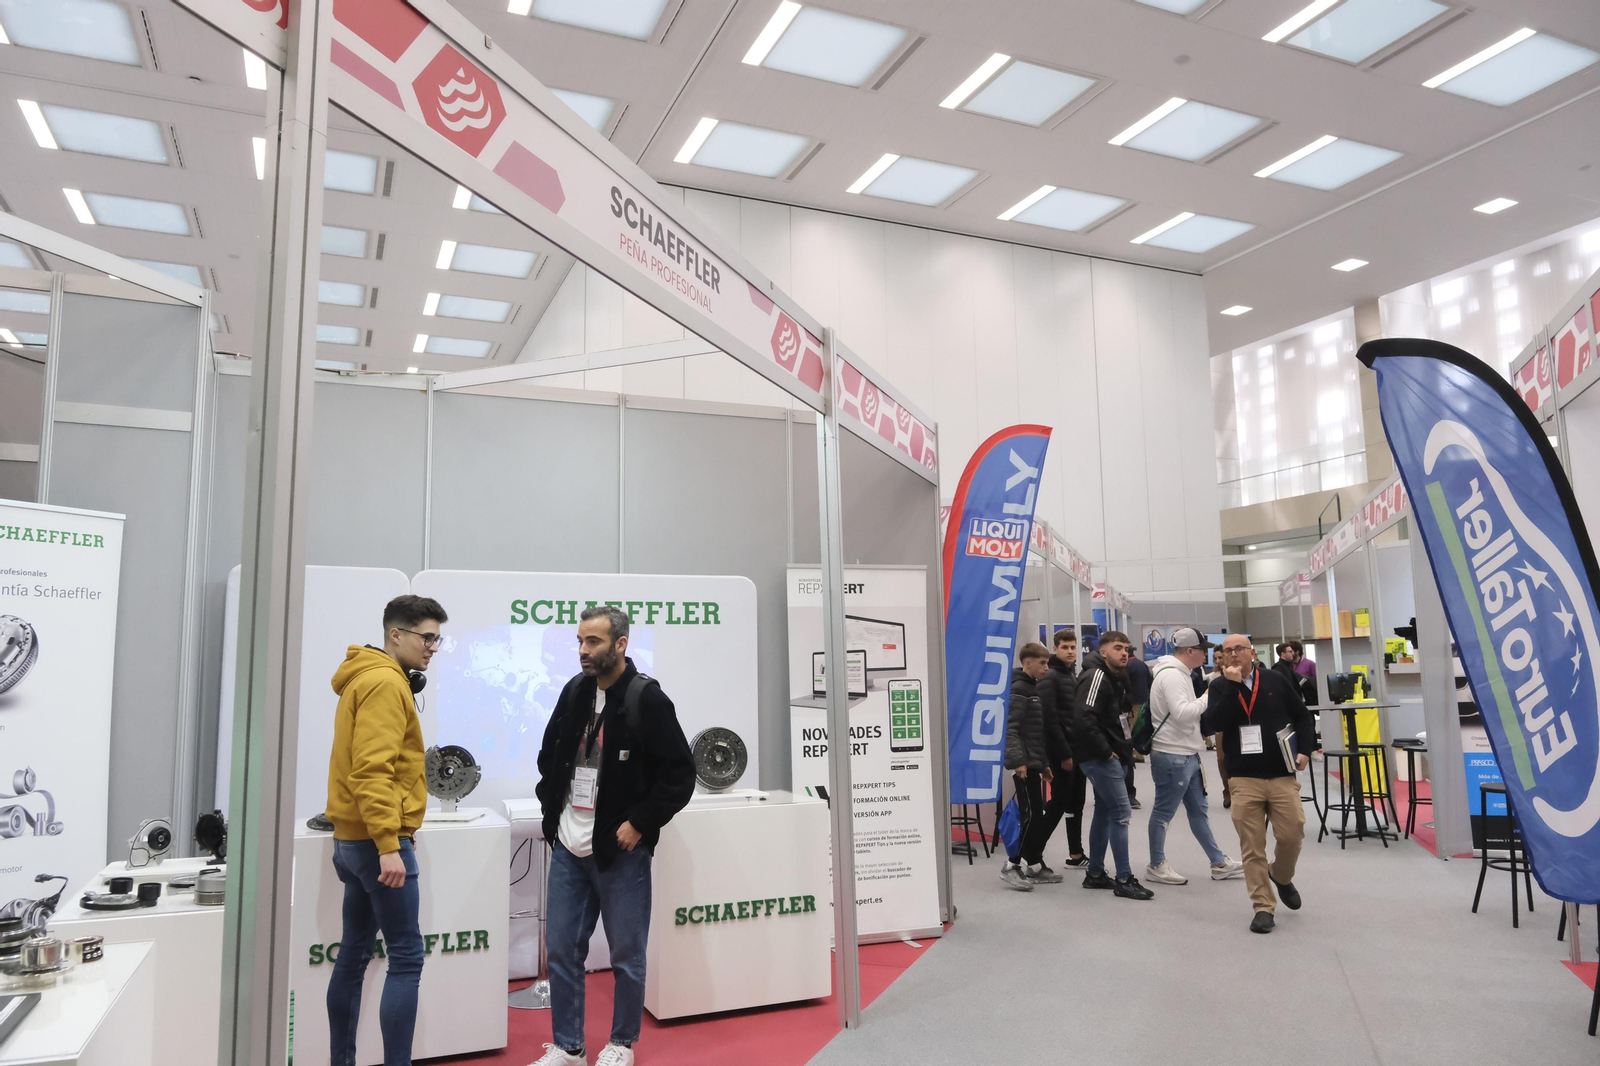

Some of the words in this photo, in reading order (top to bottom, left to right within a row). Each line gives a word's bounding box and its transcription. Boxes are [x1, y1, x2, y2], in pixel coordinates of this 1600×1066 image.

[611, 185, 720, 294] SCHAEFFLER
[620, 232, 648, 267] PEÑA
[651, 256, 713, 313] PROFESIONAL
[972, 520, 1022, 540] LIQUI
[969, 537, 1022, 557] MOLY
[34, 584, 102, 600] Schaeffler
[966, 635, 1014, 799] LIQUI
[802, 725, 882, 741] NOVADES
[675, 895, 816, 926] SCHAEFFLER
